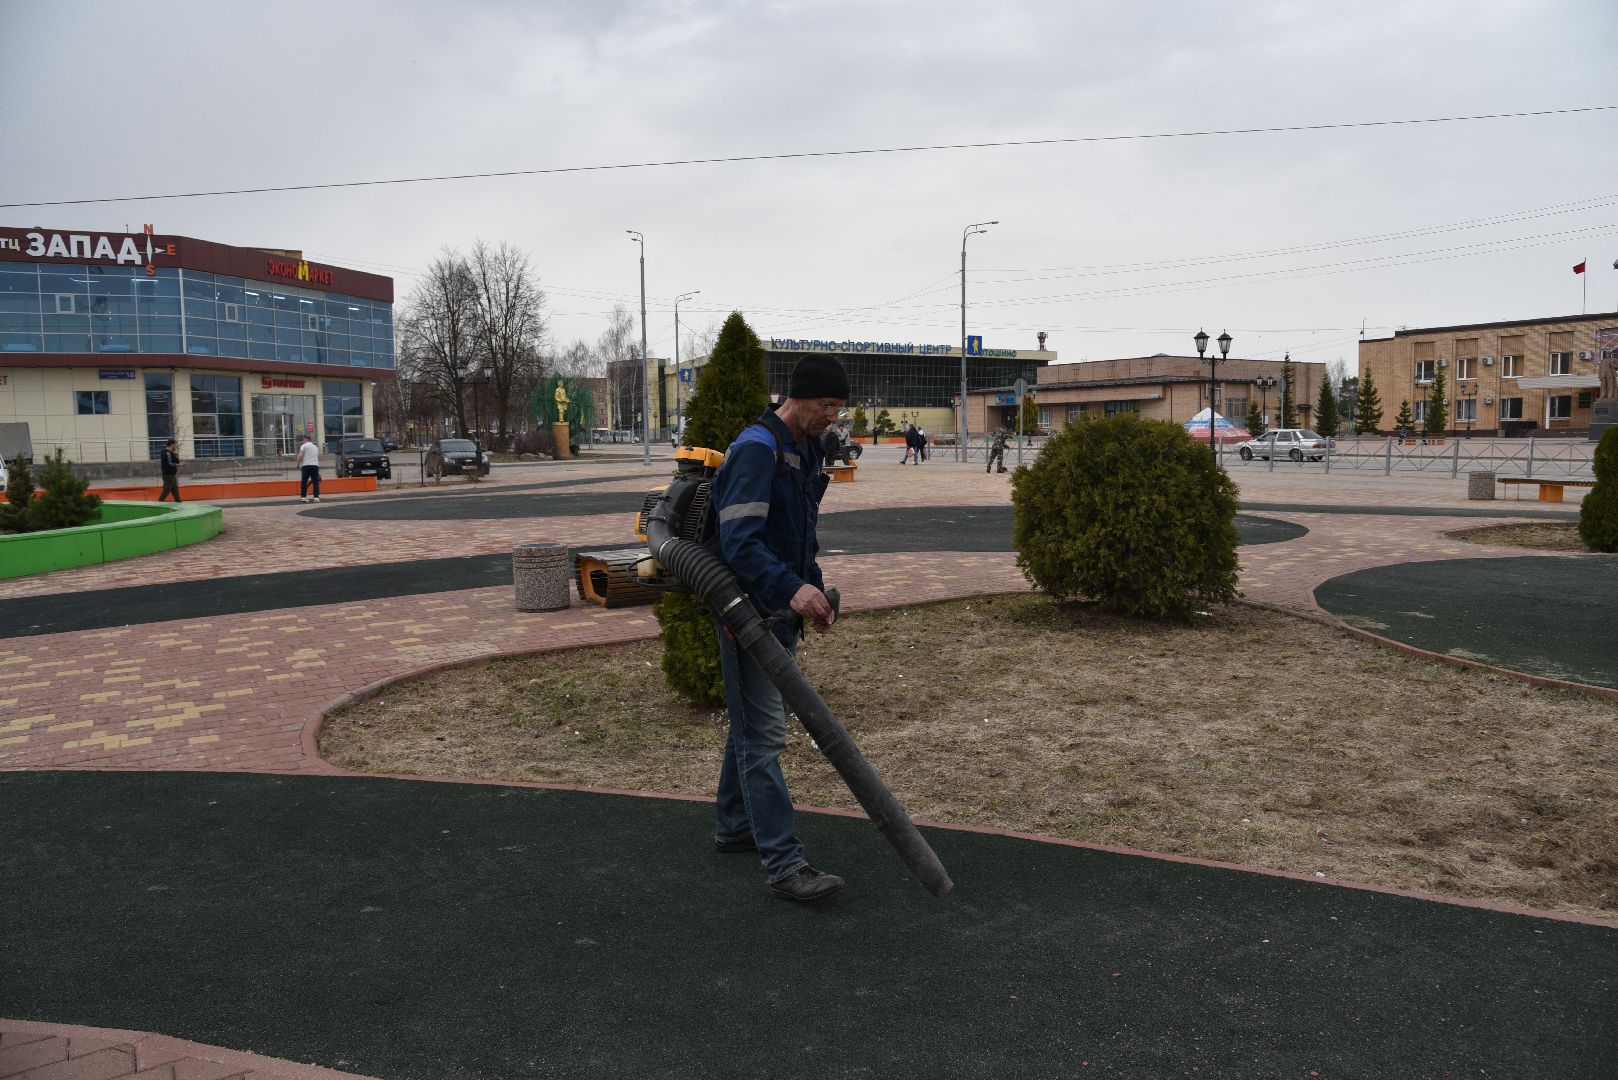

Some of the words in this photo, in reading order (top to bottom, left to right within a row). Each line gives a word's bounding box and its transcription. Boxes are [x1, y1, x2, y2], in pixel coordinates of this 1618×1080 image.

[144, 224, 153, 234] N
[26, 232, 142, 265] ЗАПАД
[167, 243, 176, 256] E
[146, 265, 155, 276] S
[771, 338, 914, 354] КУЛЬТУРНО-СПОРТИВНЫЙ
[919, 343, 952, 355] ЦЕНТР
